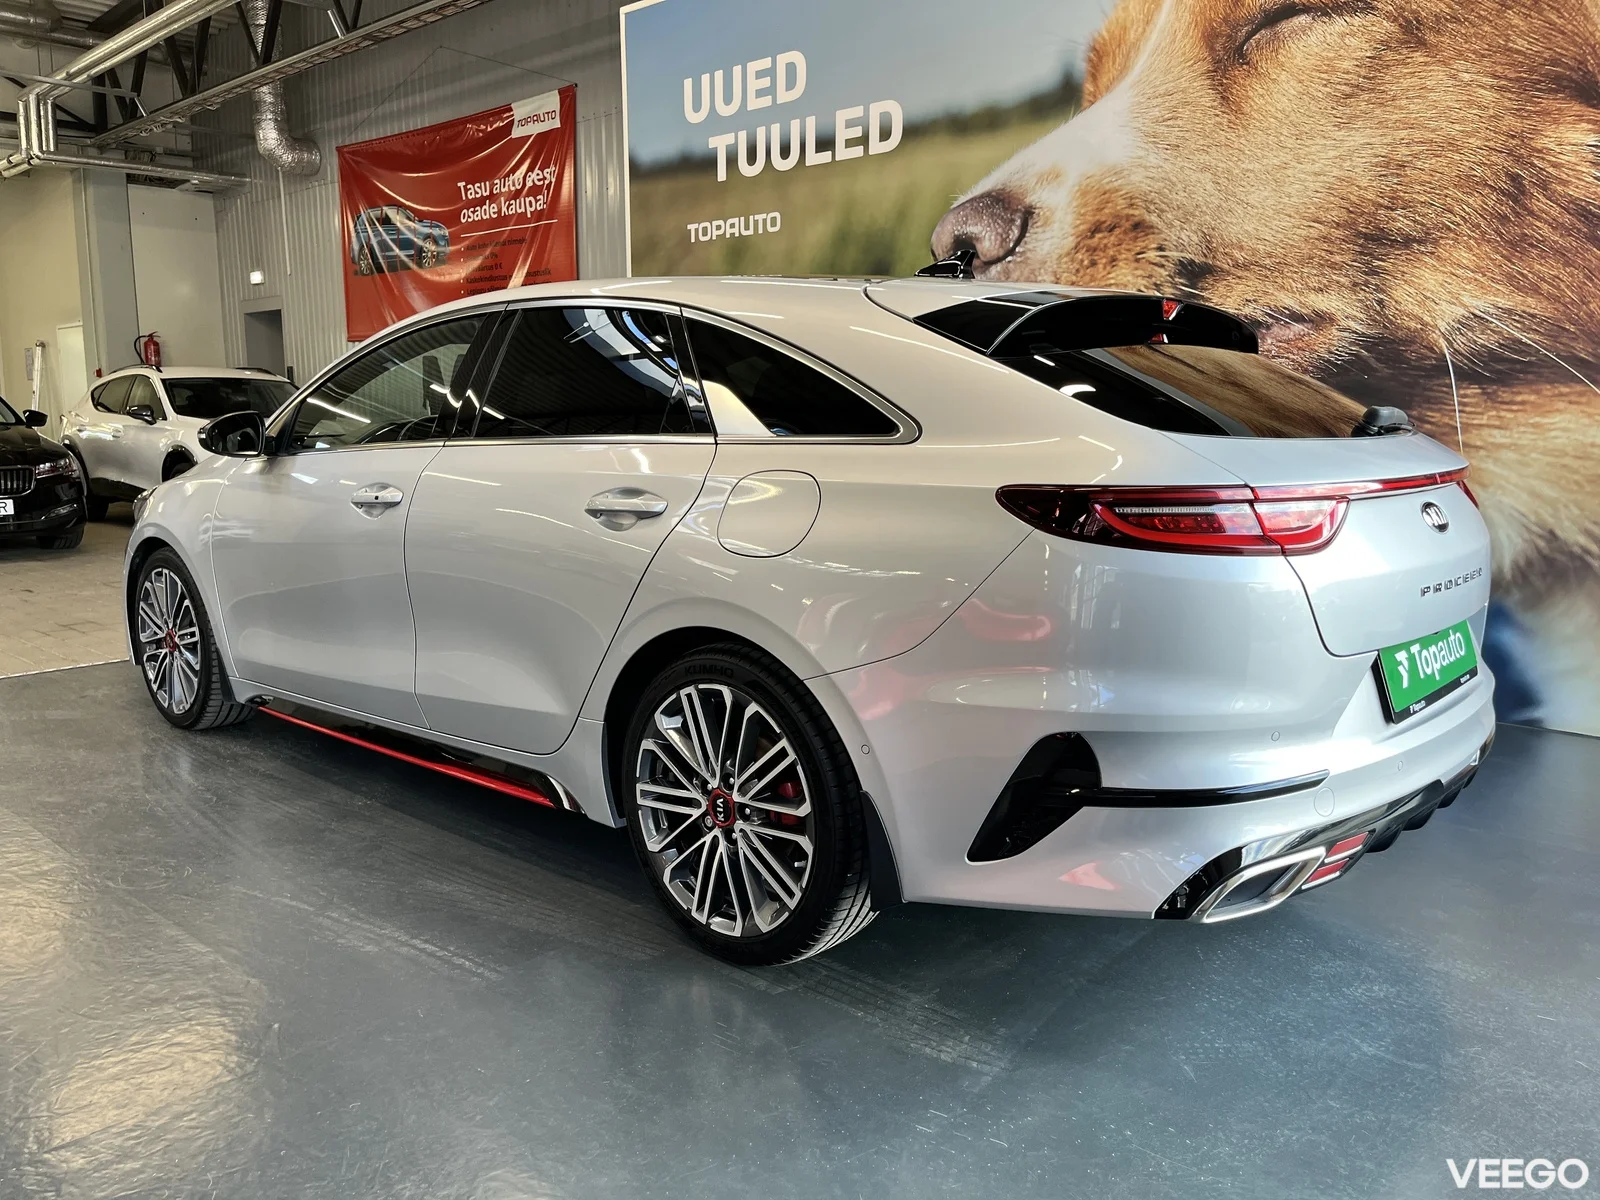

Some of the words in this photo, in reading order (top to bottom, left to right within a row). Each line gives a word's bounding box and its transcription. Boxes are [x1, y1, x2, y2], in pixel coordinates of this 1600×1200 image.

[683, 50, 807, 124] UUED
[517, 110, 557, 128] TOPAUTO
[708, 99, 904, 182] TUULED
[457, 181, 490, 200] Tasu
[493, 174, 523, 194] auto
[526, 165, 556, 187] eest
[460, 200, 498, 223] osade
[501, 190, 547, 218] kaupa!
[687, 211, 781, 243] TOPAUTO
[1420, 567, 1483, 597] PROCEED
[1410, 629, 1465, 681] Topauto
[716, 798, 725, 822] KIA
